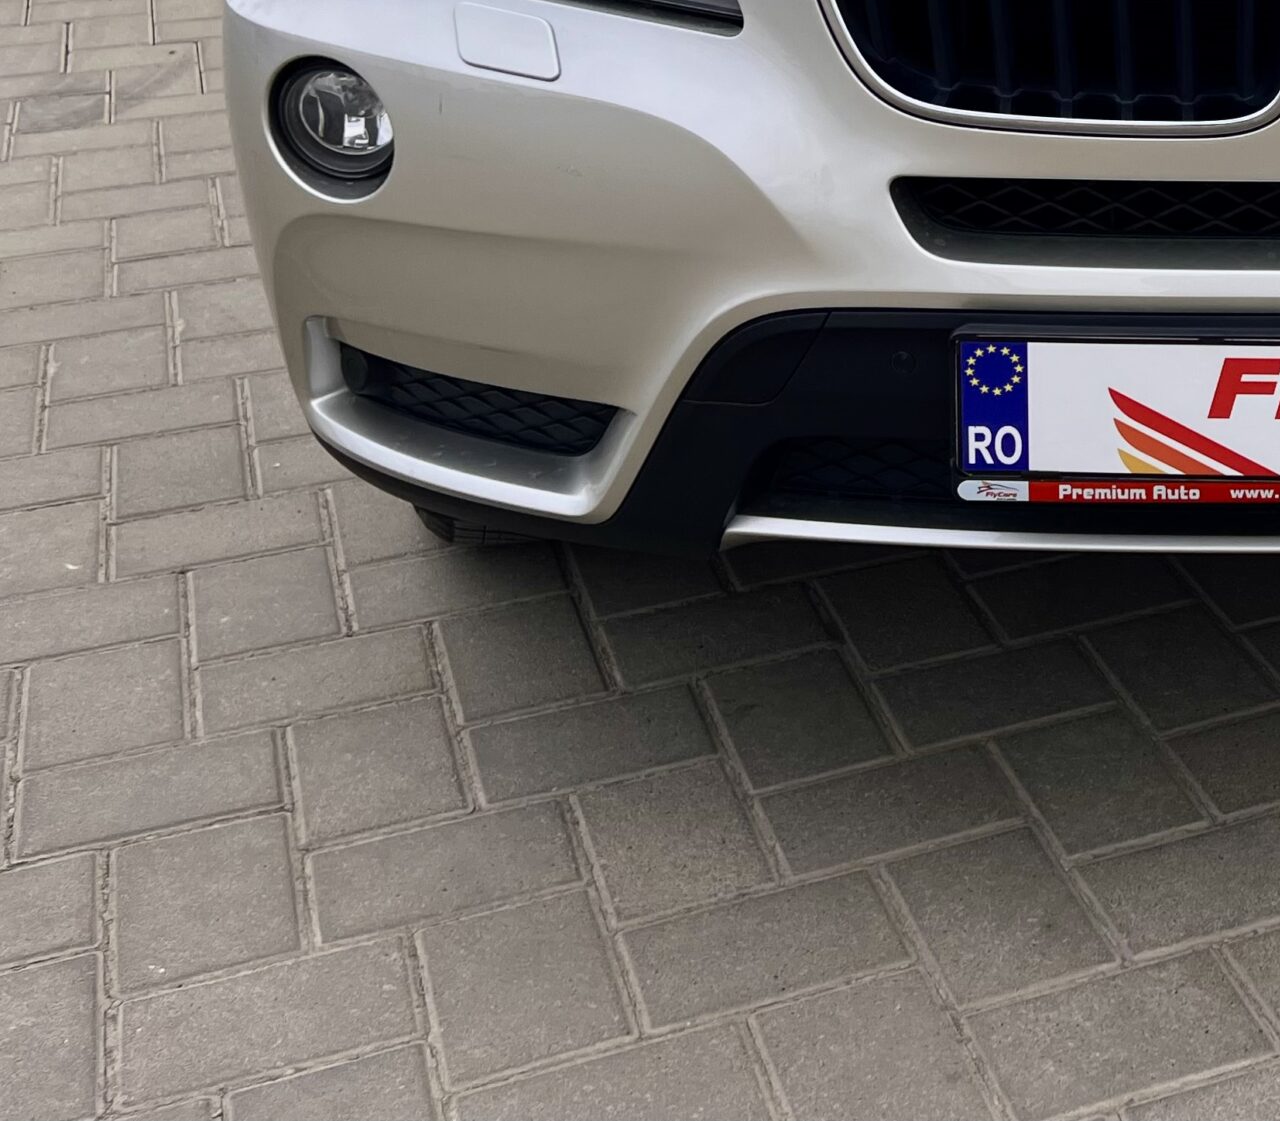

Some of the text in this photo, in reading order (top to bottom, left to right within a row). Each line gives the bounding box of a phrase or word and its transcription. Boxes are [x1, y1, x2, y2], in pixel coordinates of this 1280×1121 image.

[967, 425, 1023, 465] RO
[1058, 484, 1147, 500] Premium
[1153, 485, 1201, 500] Auto
